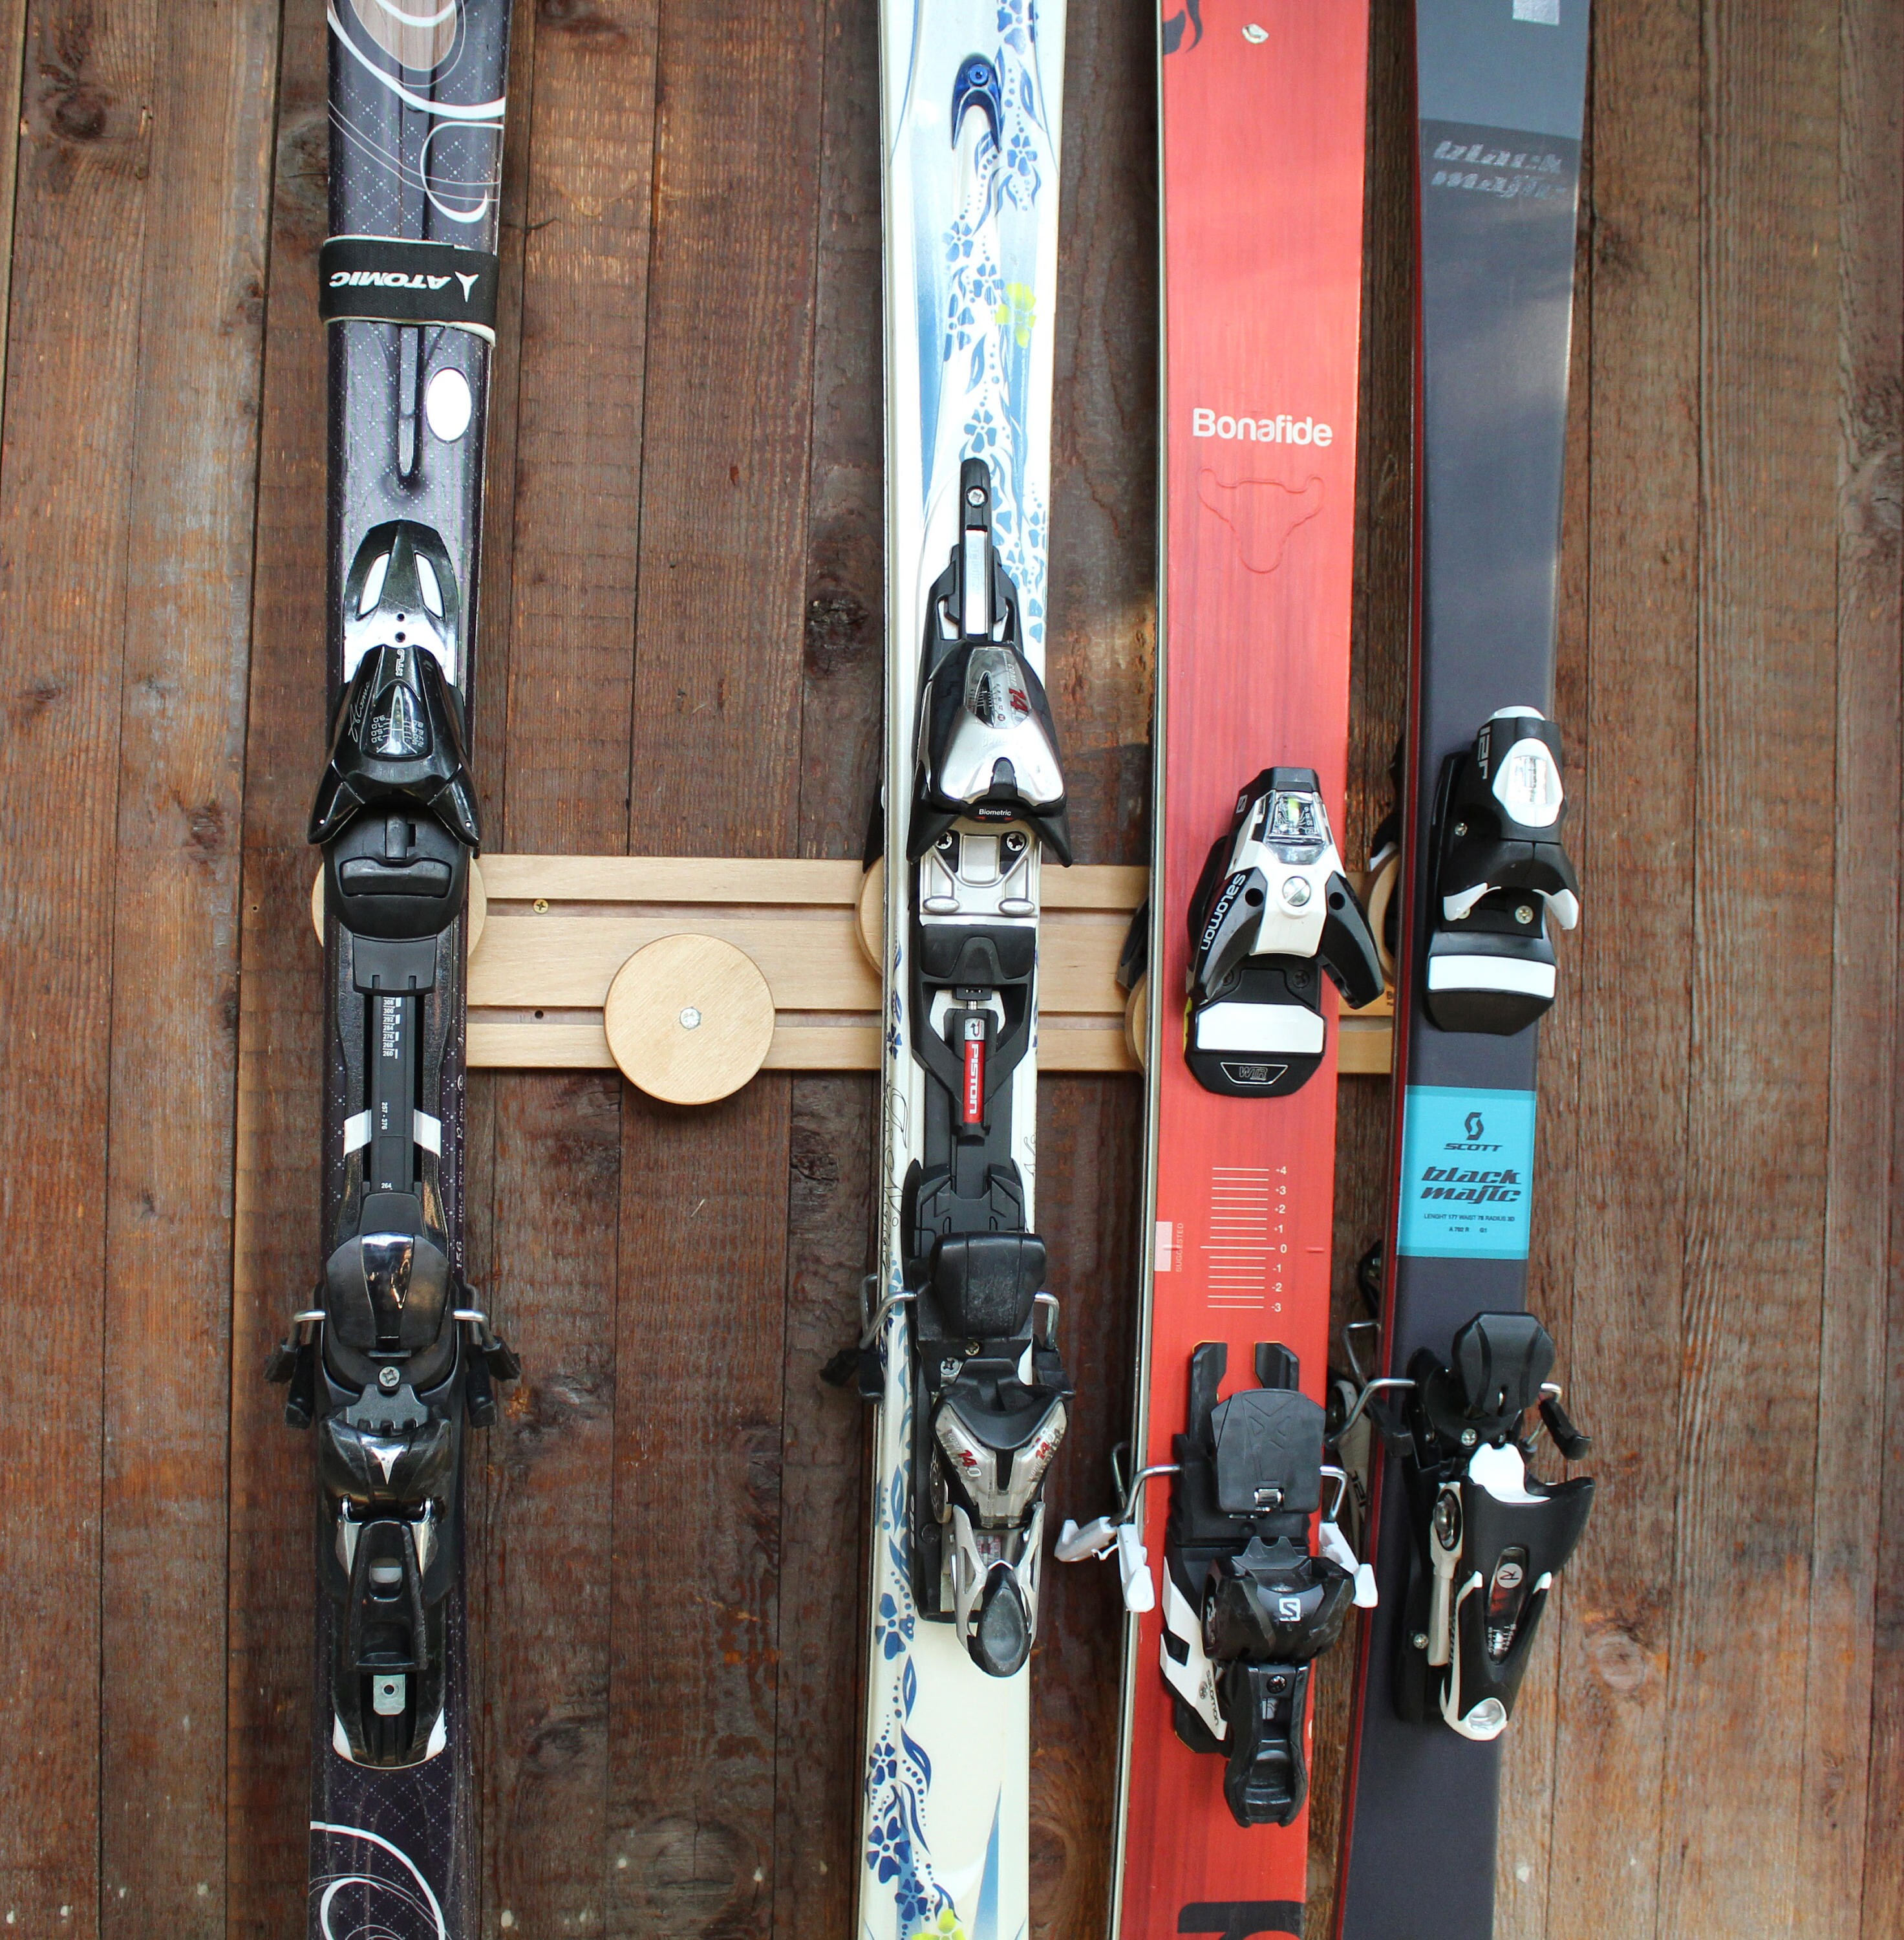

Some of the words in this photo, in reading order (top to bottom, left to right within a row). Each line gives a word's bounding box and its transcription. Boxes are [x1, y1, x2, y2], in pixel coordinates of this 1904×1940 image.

[328, 271, 452, 290] ATOMIC
[1193, 407, 1333, 446] Bonafide
[1201, 874, 1246, 951] salomon
[1239, 1066, 1268, 1079] WTR
[968, 1044, 979, 1115] PISTON
[1444, 1143, 1503, 1152] SCOTT
[1275, 1166, 1287, 1175] +4
[1421, 1166, 1521, 1185] black
[1275, 1186, 1287, 1195] +3
[1420, 1185, 1521, 1204] majic
[1274, 1205, 1286, 1214] +2
[1274, 1225, 1283, 1233] +1
[1175, 1223, 1184, 1273] SUGGESTED
[1280, 1244, 1287, 1253] 0
[1272, 1264, 1282, 1273] -1
[1272, 1283, 1282, 1292] -2
[1271, 1303, 1282, 1312] -3
